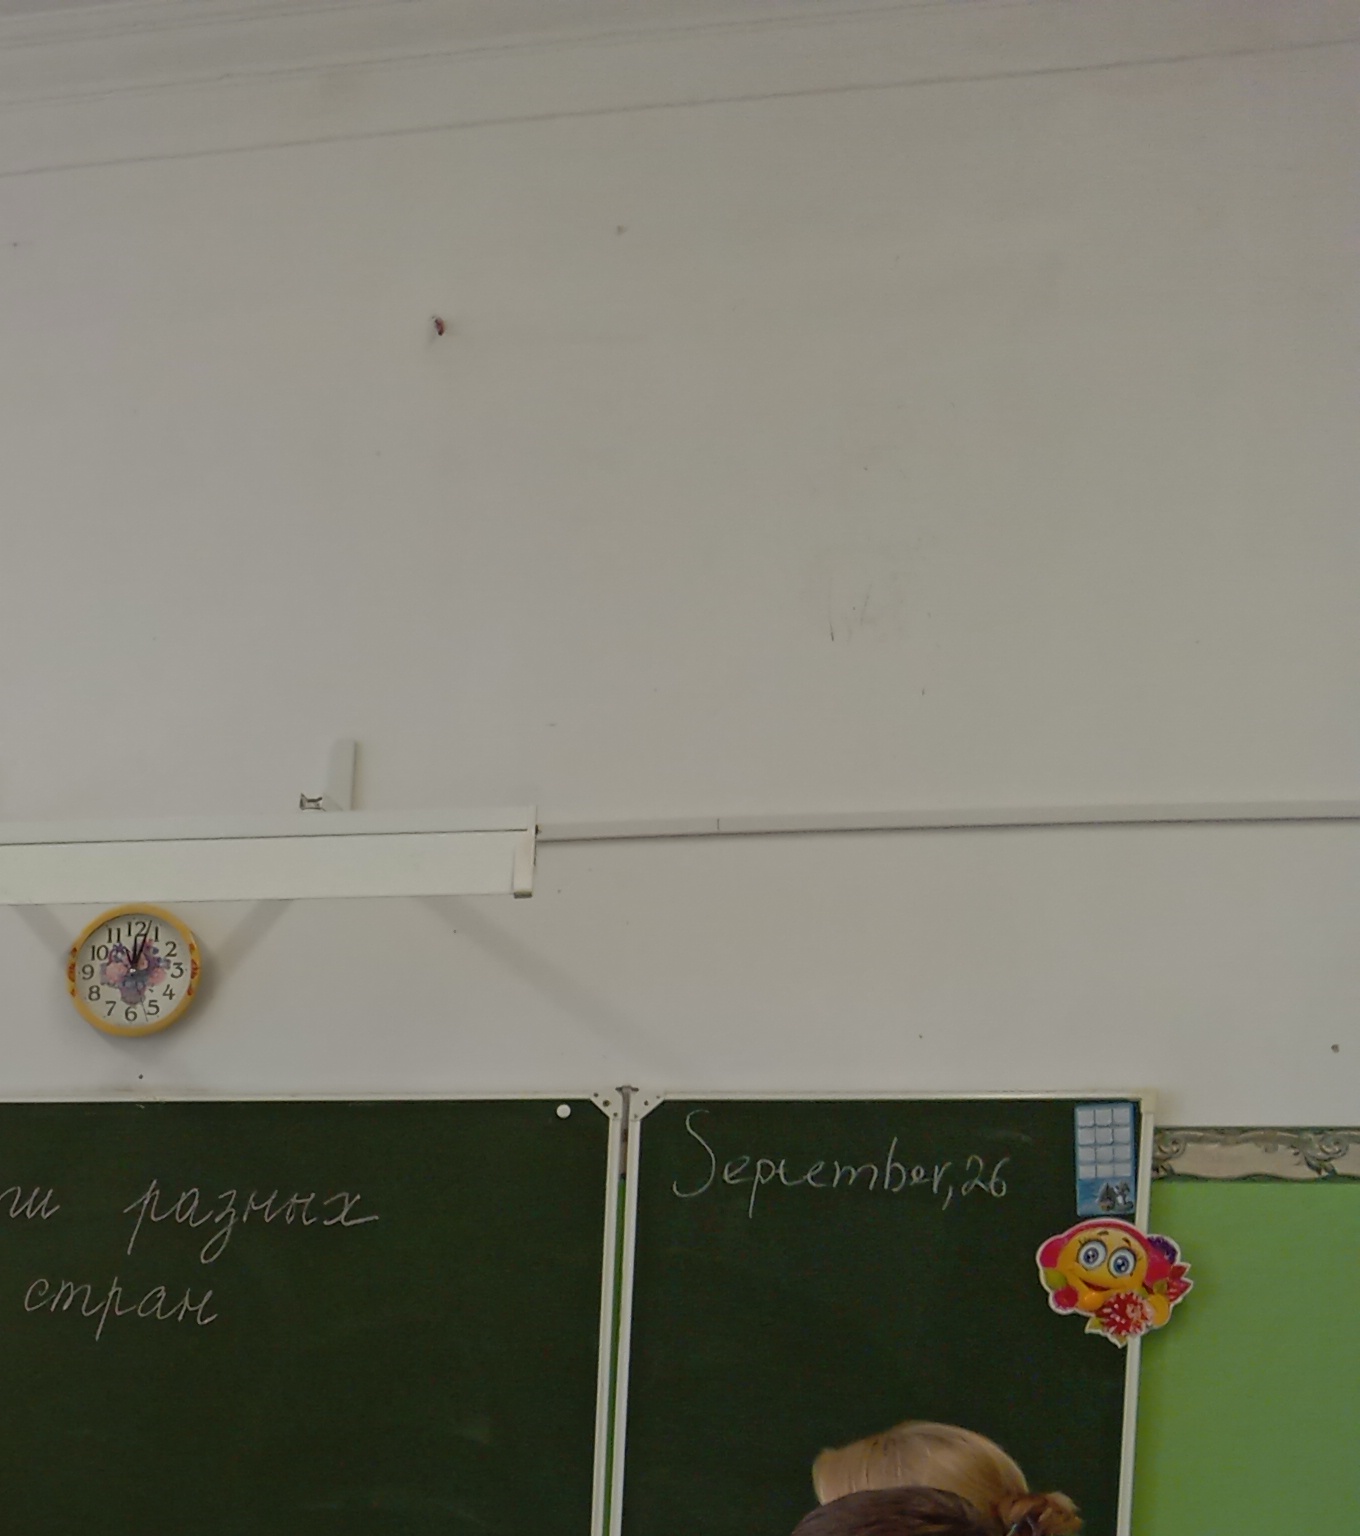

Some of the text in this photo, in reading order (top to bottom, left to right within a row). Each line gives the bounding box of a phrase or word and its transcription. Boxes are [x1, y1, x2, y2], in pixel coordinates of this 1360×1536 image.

[107, 927, 121, 943] 11
[127, 921, 147, 937] 12
[154, 926, 160, 942] 1
[90, 944, 109, 961] 10
[165, 941, 177, 957] 2
[81, 964, 94, 980] 9
[170, 962, 184, 978] 3
[88, 985, 101, 1001] 8
[162, 984, 176, 1000] 4
[105, 1000, 117, 1016] 7
[124, 1006, 138, 1022] 6
[147, 1000, 160, 1016] 5
[123, 1178, 381, 1265] разных
[23, 1275, 219, 1341] стран
